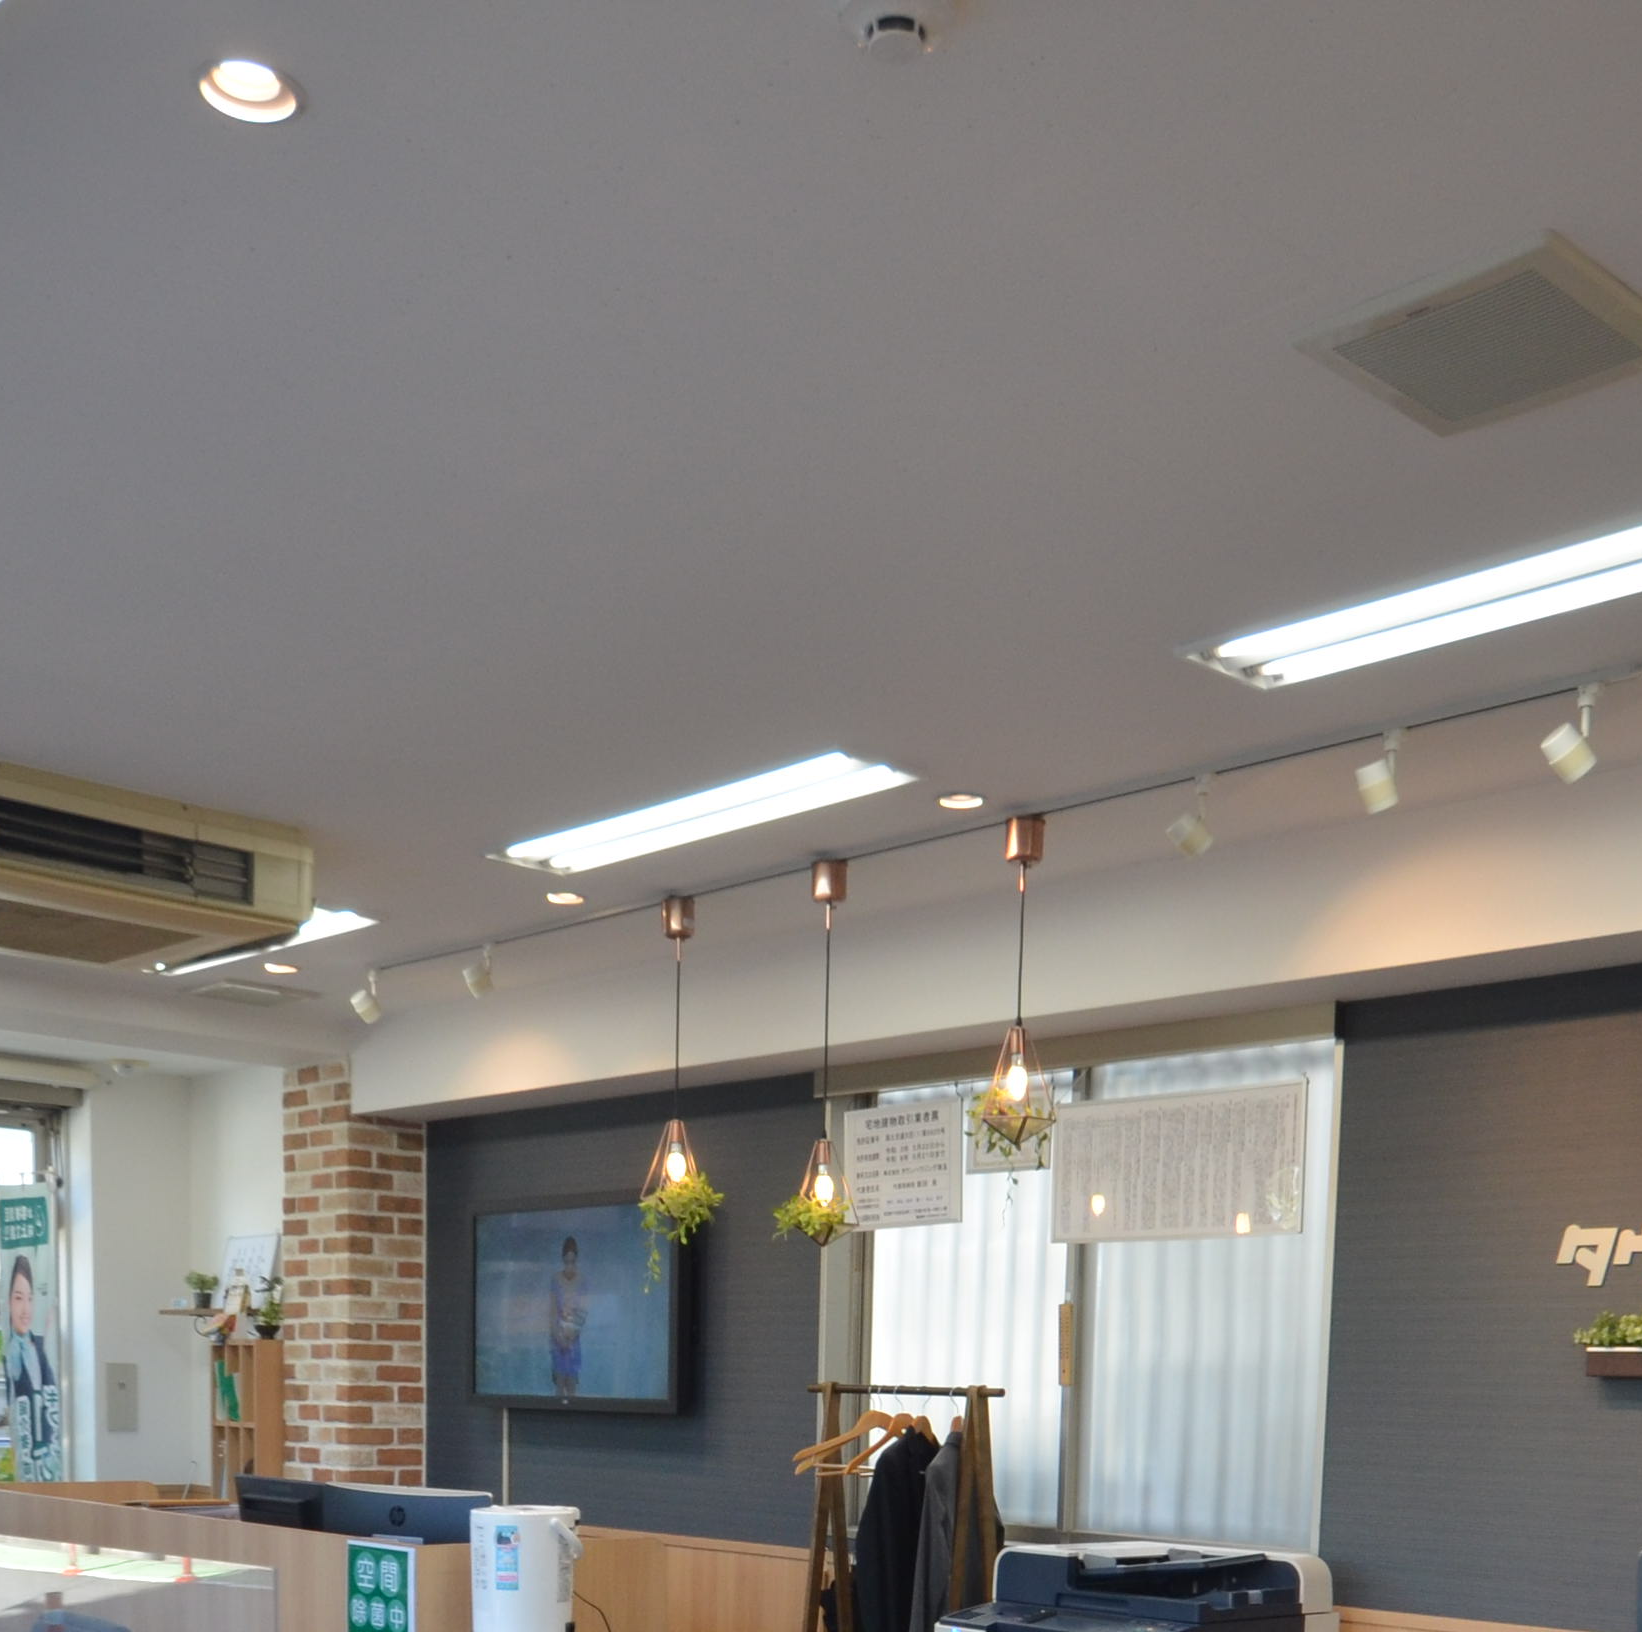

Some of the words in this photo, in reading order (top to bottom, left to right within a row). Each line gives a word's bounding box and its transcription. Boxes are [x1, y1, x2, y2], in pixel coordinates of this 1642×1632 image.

[357, 1558, 398, 1592] 空間
[352, 1598, 404, 1629] 除菌中
